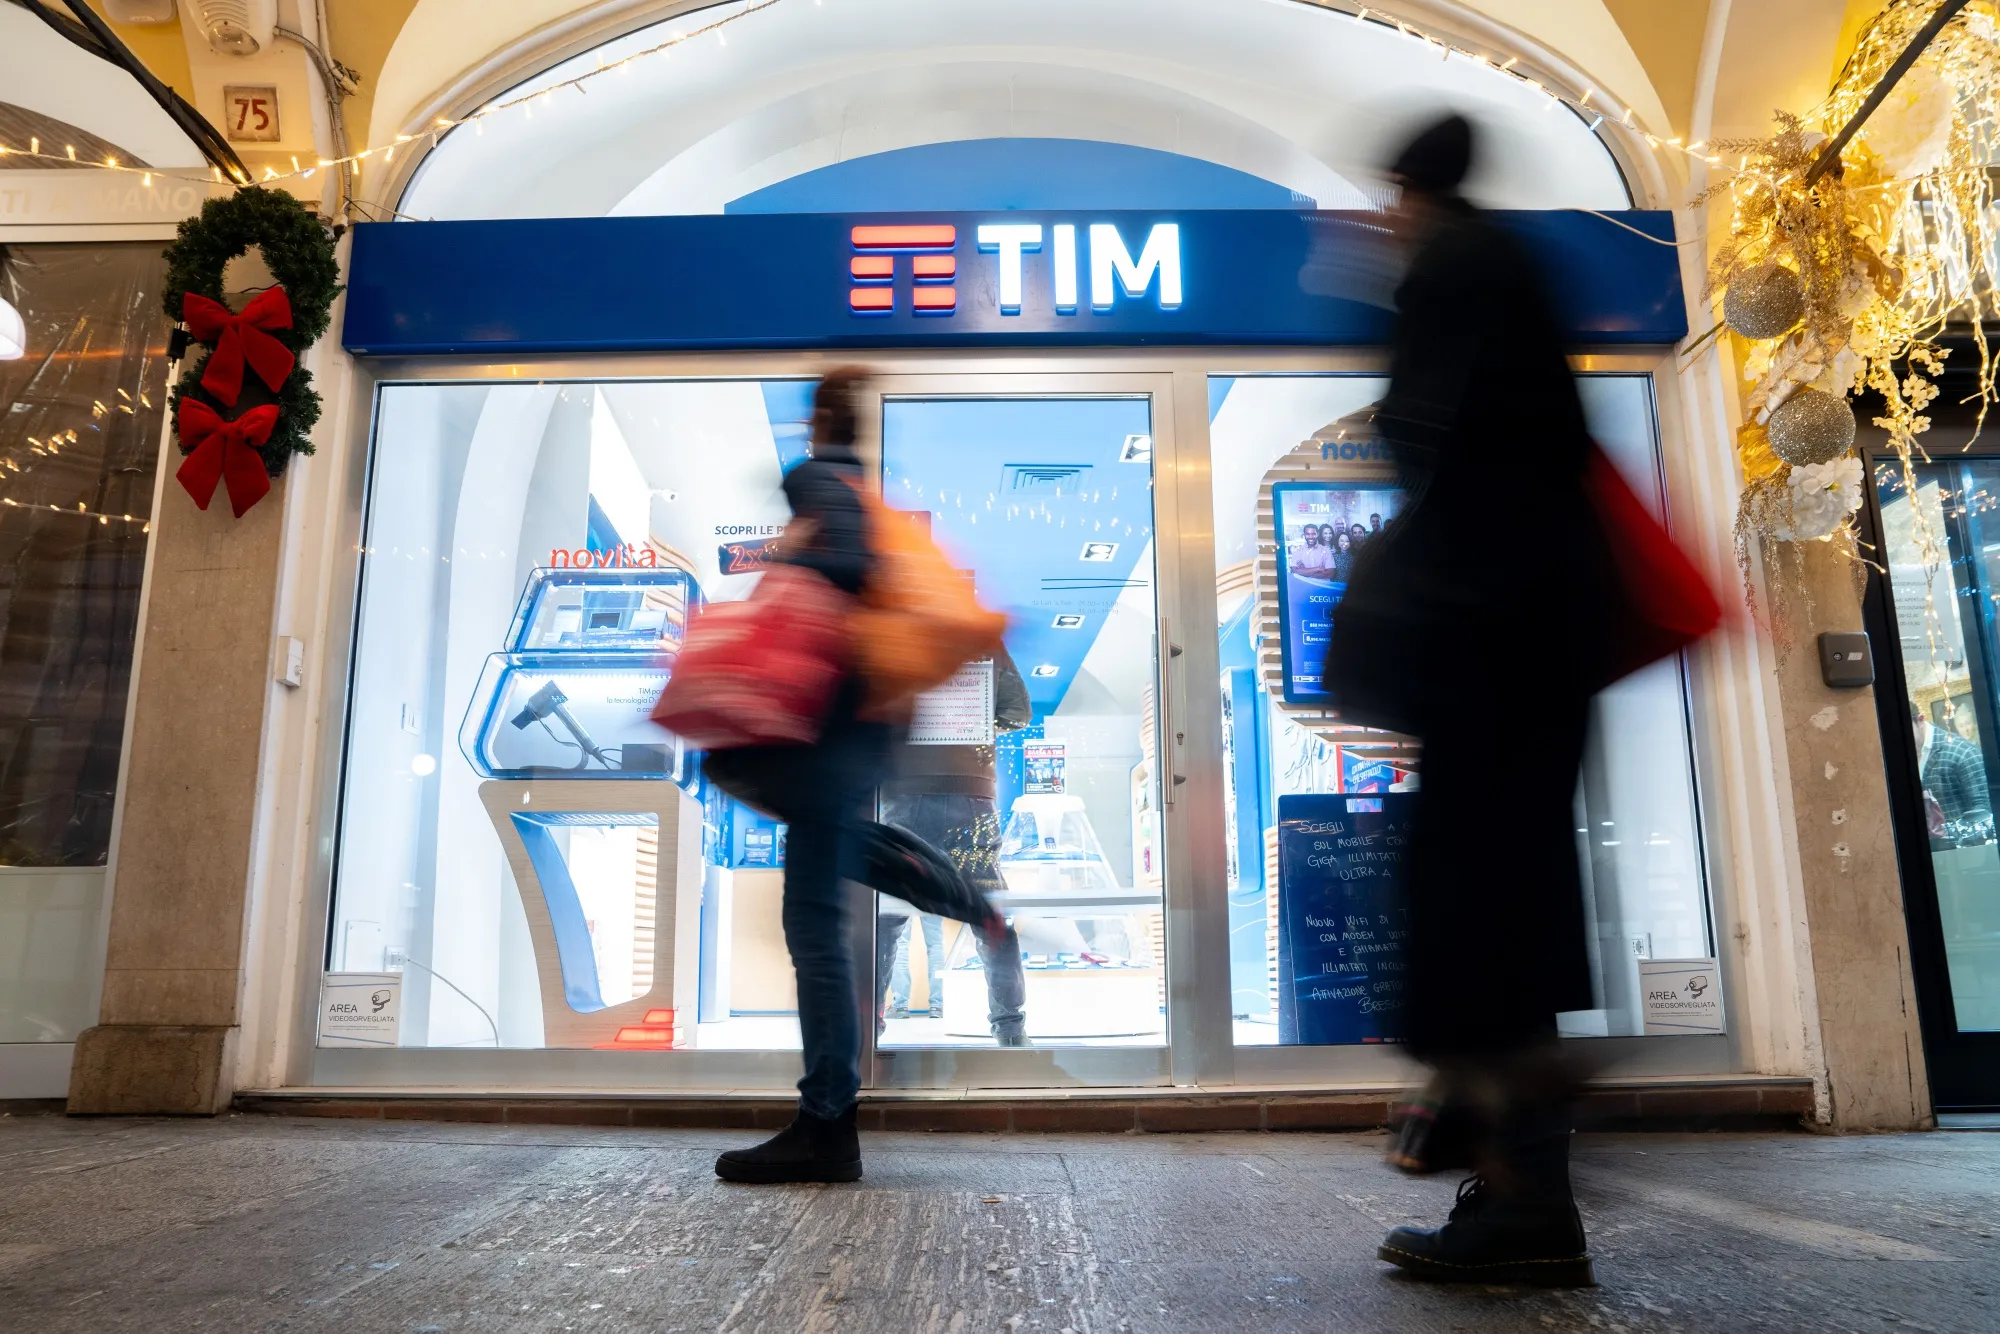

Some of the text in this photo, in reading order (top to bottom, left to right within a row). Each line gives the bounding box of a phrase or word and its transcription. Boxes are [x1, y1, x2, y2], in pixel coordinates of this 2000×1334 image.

[234, 98, 269, 131] 75
[977, 223, 1182, 310] TIM
[1321, 438, 1391, 461] novit
[1309, 503, 1330, 513] TIM
[714, 525, 757, 535] SCOPRI
[760, 525, 774, 535] LE
[550, 541, 657, 568] novità
[1309, 595, 1335, 603] SCEGLI
[638, 687, 651, 695] TIM
[1299, 820, 1345, 834] SCEGLI
[1387, 823, 1396, 832] A
[1313, 840, 1333, 851] SUL
[1338, 836, 1374, 849] MOBILE
[1307, 854, 1338, 869] GIGA
[1339, 866, 1392, 881] ULTRA A
[1305, 914, 1335, 928] NUOVO
[1344, 914, 1369, 927] WIFI
[1379, 914, 1389, 925] DI
[1319, 932, 1338, 943] CON
[1342, 930, 1375, 941] MODEM
[1337, 942, 1400, 957] E CHIAMATE
[1322, 961, 1369, 975] ILLIMITATI
[1312, 985, 1368, 1001] ATTIVAZIONE
[1648, 990, 1678, 1001] AREA
[329, 1003, 358, 1013] AREA
[1649, 1001, 1716, 1009] VIDEOSORVEGLIATA
[328, 1015, 395, 1023] VIDEOSORVEGLIATA
